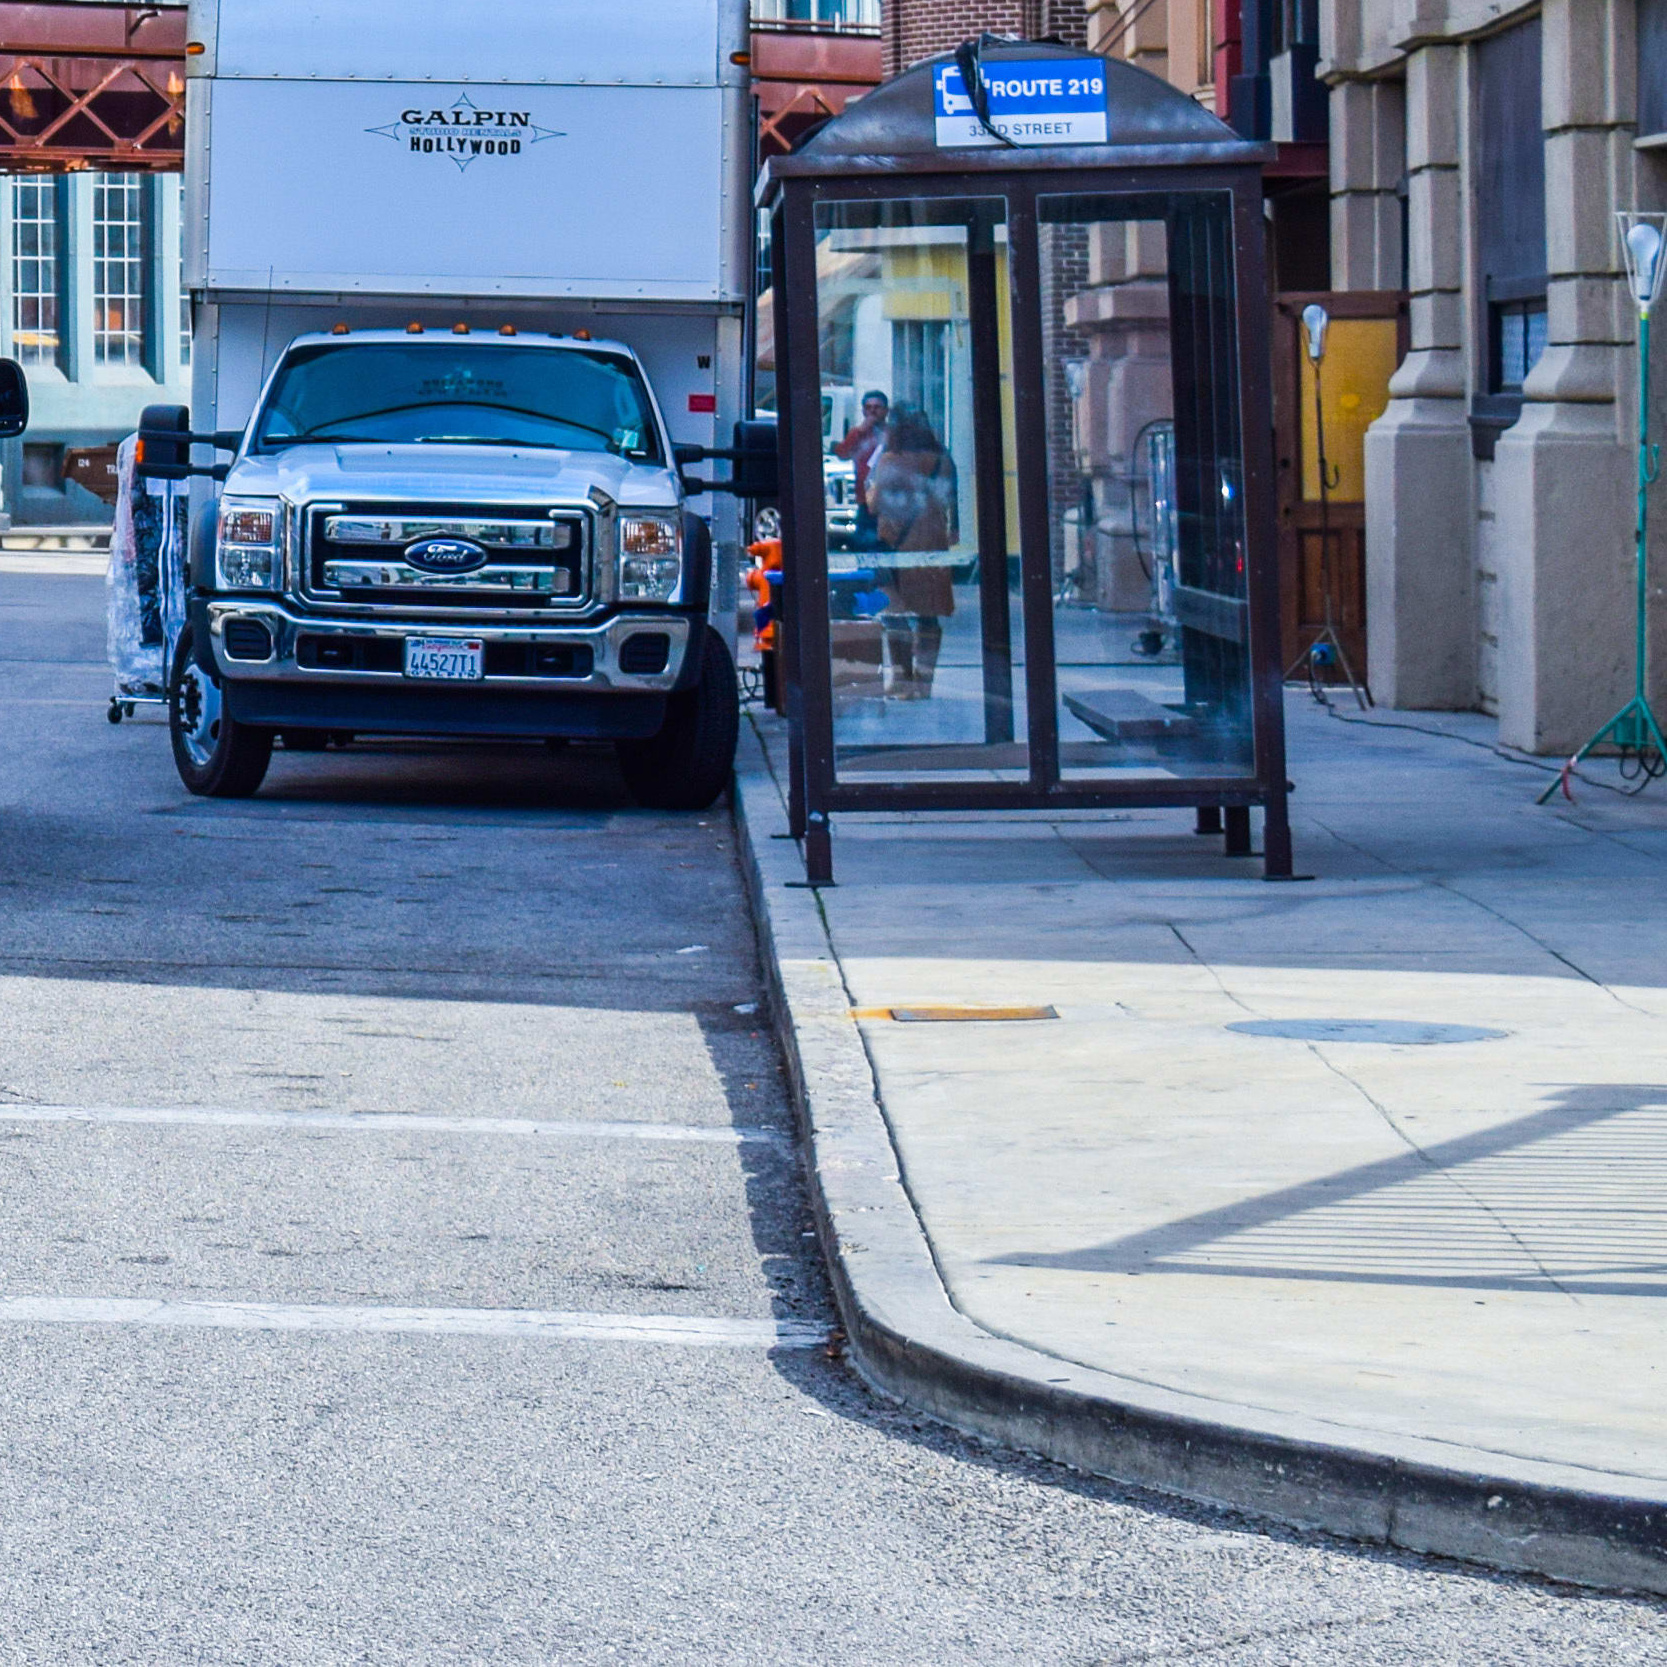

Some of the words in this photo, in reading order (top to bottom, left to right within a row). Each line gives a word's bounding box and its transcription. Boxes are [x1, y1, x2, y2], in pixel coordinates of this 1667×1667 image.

[992, 79, 1063, 97] ROUTE
[1068, 78, 1104, 95] 219
[401, 110, 530, 126] GALPIN
[1013, 122, 1072, 135] STREET
[410, 136, 520, 155] HOLLYWOOD
[697, 356, 710, 369] W
[423, 544, 468, 563] Ford
[411, 653, 476, 672] 44527T1
